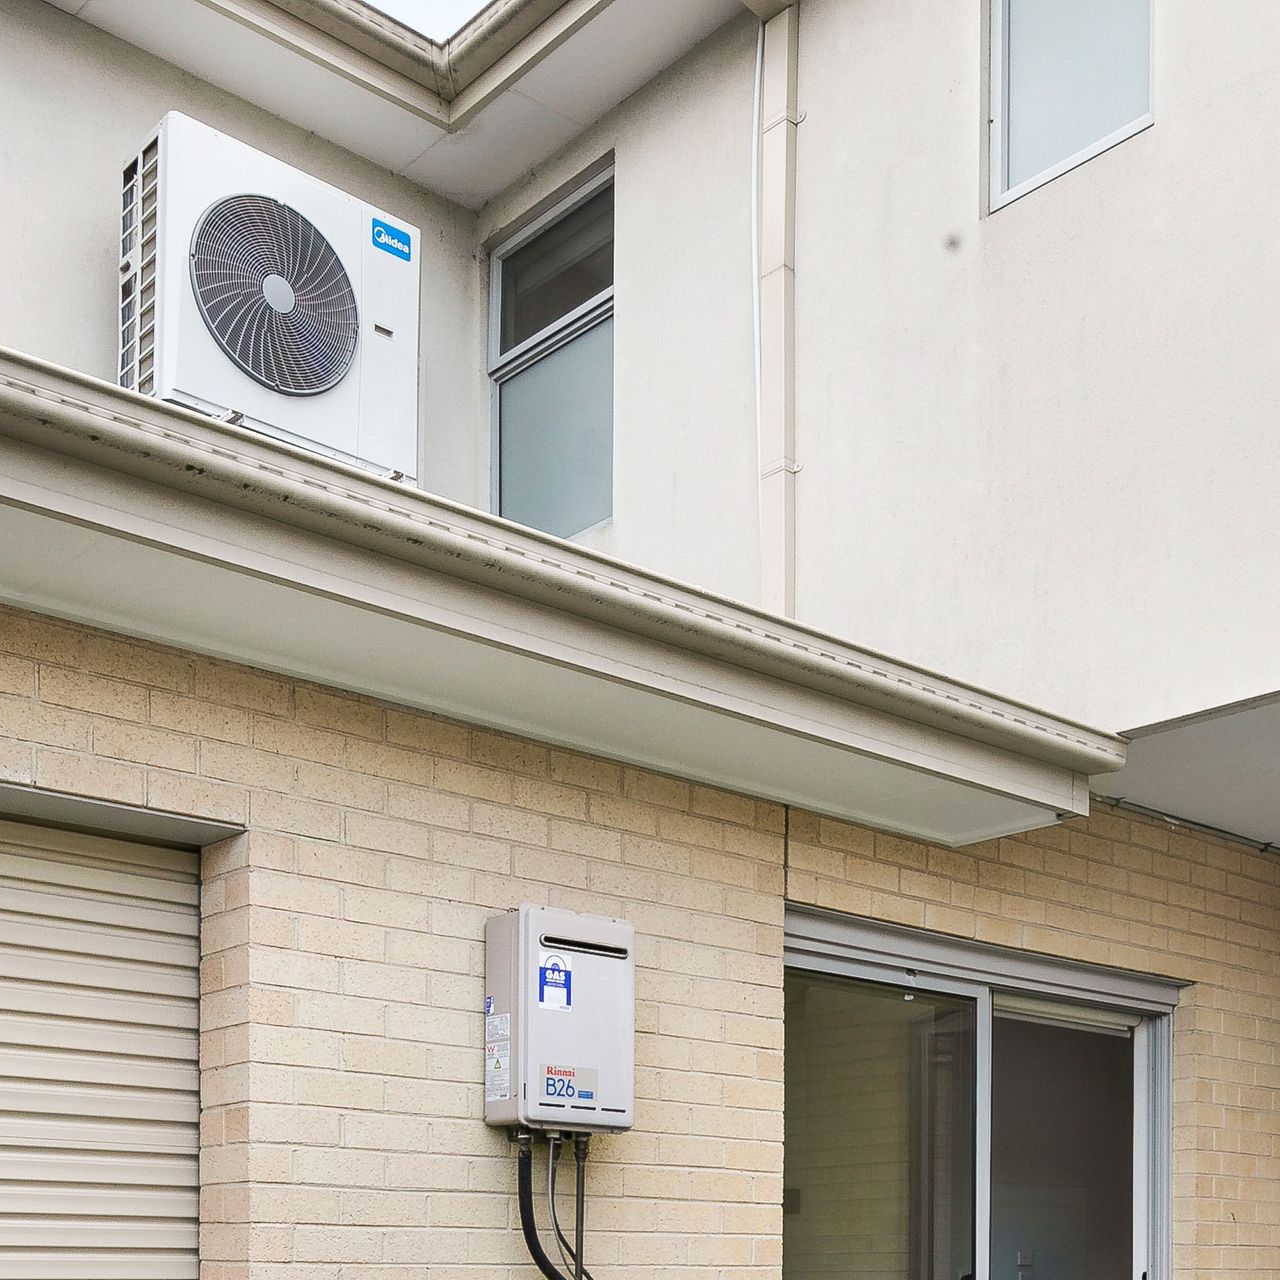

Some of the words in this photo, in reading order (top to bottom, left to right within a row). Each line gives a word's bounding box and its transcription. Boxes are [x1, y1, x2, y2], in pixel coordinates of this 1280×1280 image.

[374, 226, 409, 254] Midea
[545, 969, 566, 981] GAS
[546, 1066, 575, 1077] Rinnai
[546, 1077, 575, 1097] B26
